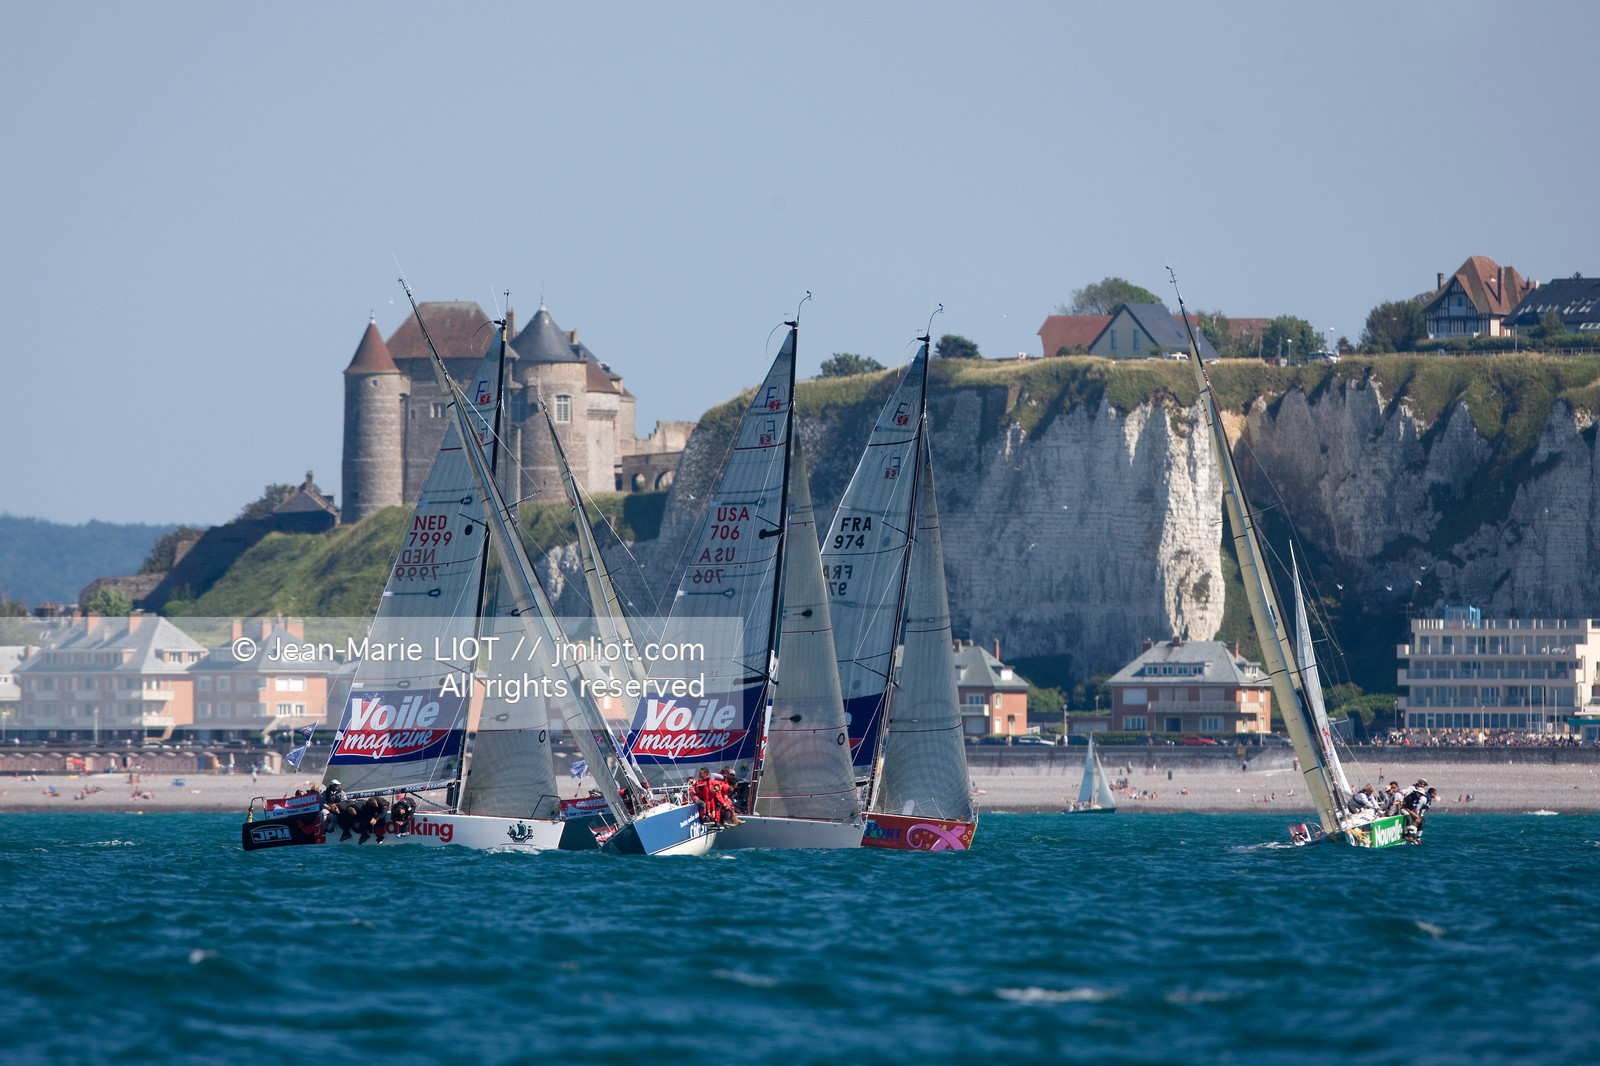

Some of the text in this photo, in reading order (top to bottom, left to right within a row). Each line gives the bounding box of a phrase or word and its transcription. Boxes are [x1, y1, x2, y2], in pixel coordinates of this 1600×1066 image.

[717, 506, 750, 522] USA
[414, 515, 448, 531] NED
[840, 517, 872, 532] FRA
[409, 531, 453, 548] 7999
[710, 525, 740, 541] 706
[833, 534, 865, 550] 974
[350, 695, 440, 731] Voile
[645, 698, 736, 732] Voile
[344, 728, 433, 759] magazine
[639, 731, 731, 760] magazine
[252, 827, 290, 841] JPM
